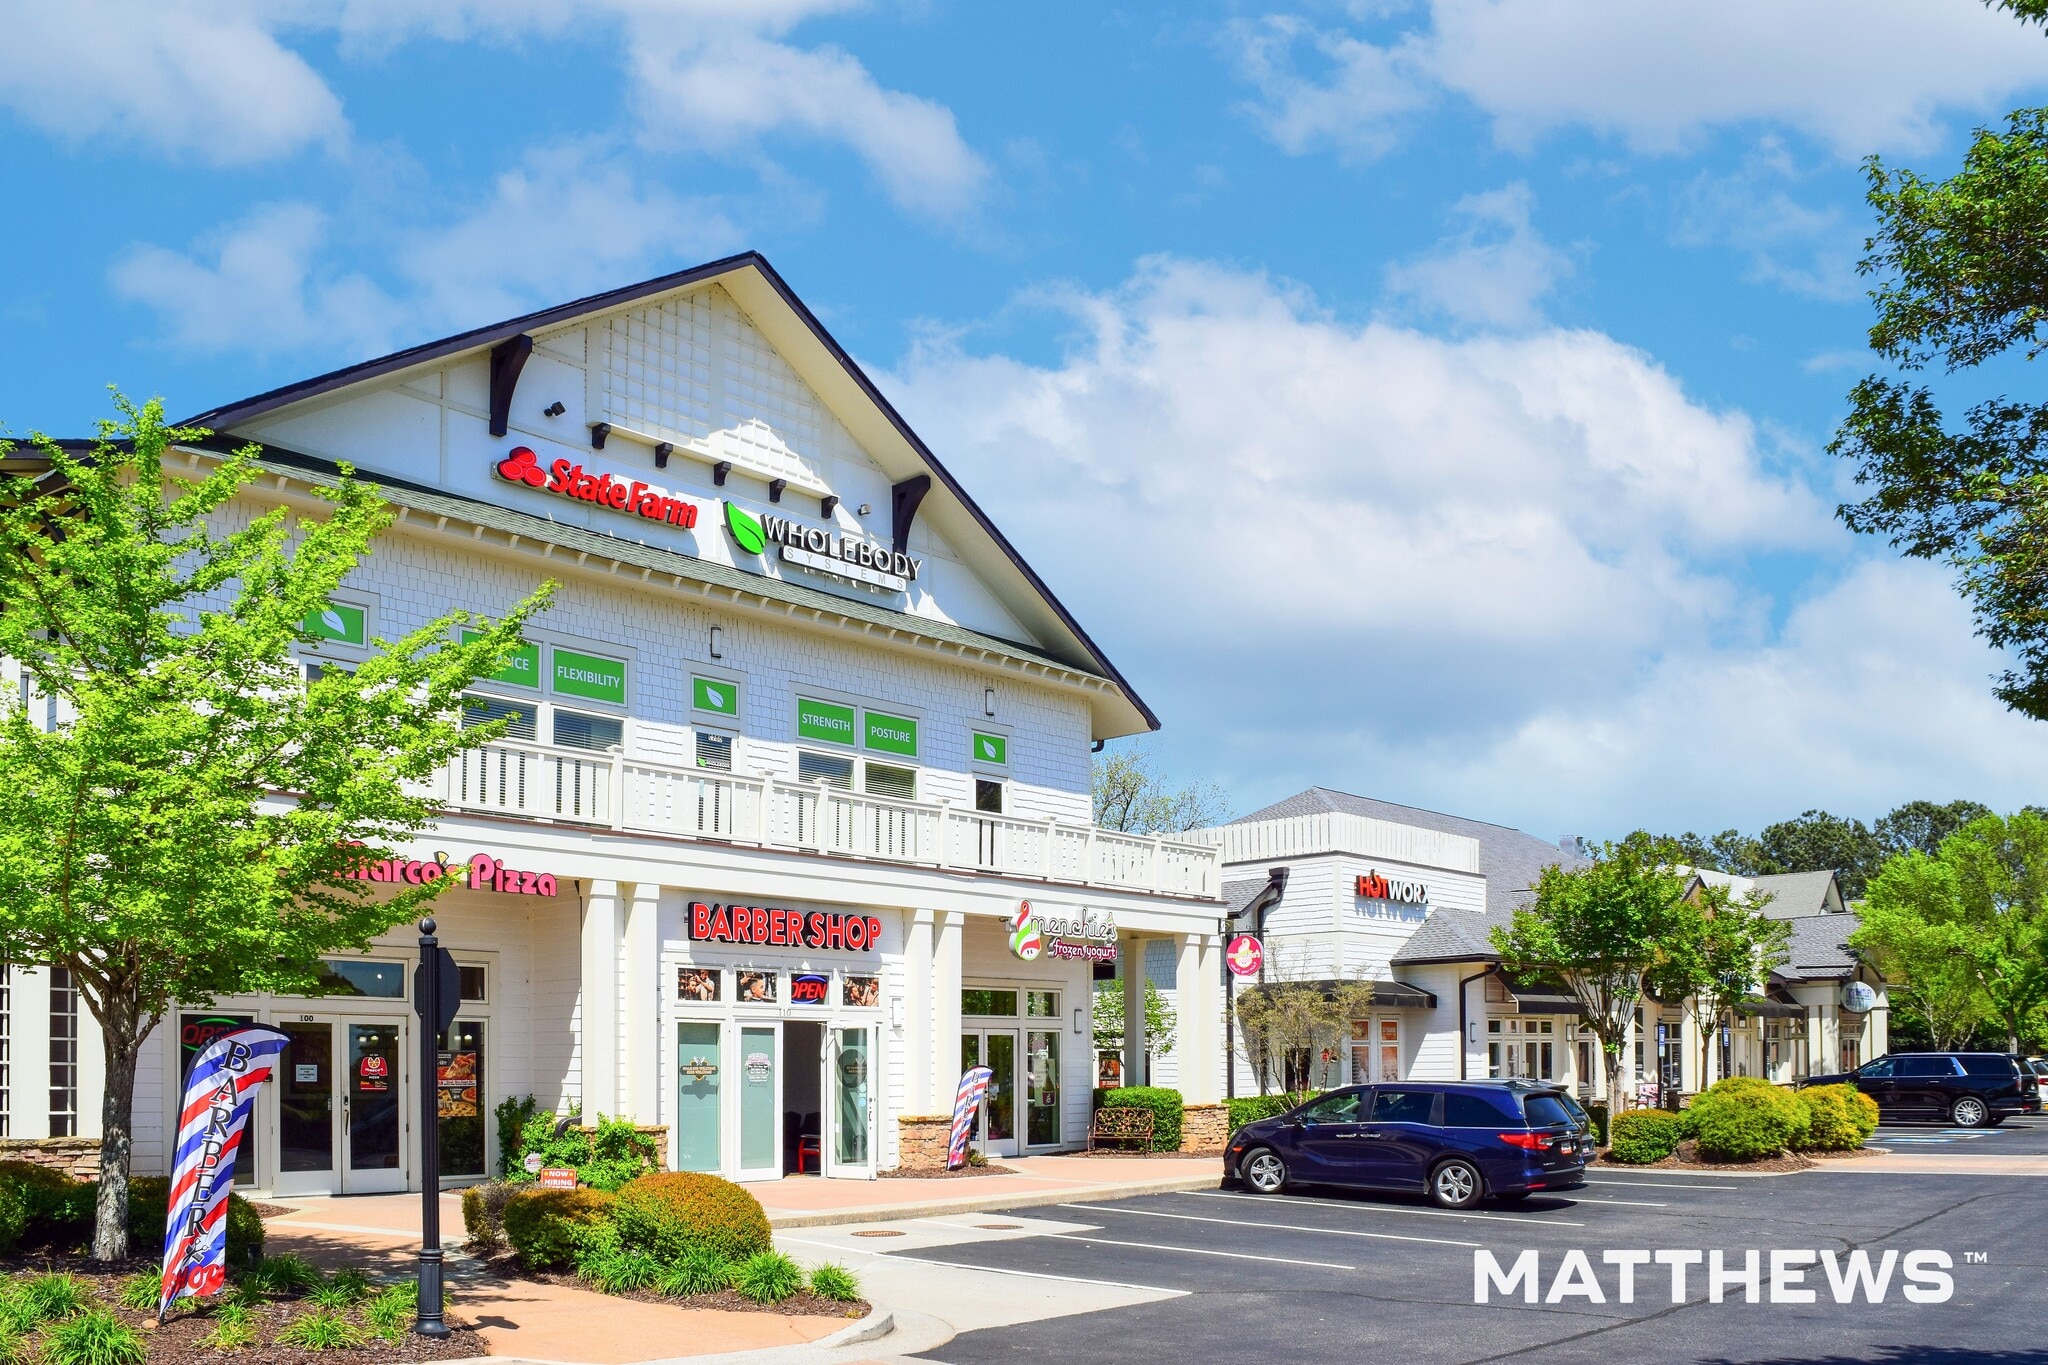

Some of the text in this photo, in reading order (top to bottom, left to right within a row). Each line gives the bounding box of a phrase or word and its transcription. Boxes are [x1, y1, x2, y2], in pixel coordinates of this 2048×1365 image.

[762, 514, 923, 580] WHOLEBODY
[787, 546, 906, 590] SYSTEMS
[557, 665, 620, 689] FLEXIBILITY
[802, 713, 850, 732] STRENGTH
[871, 726, 910, 743] POSTURE
[468, 853, 557, 897] Pizza
[1357, 870, 1430, 904] HOTWORX
[691, 902, 883, 950] BARBER SHOP
[1054, 937, 1117, 961] frozen yogurt
[791, 982, 827, 999] OPEN
[185, 1040, 252, 1237] BARBER
